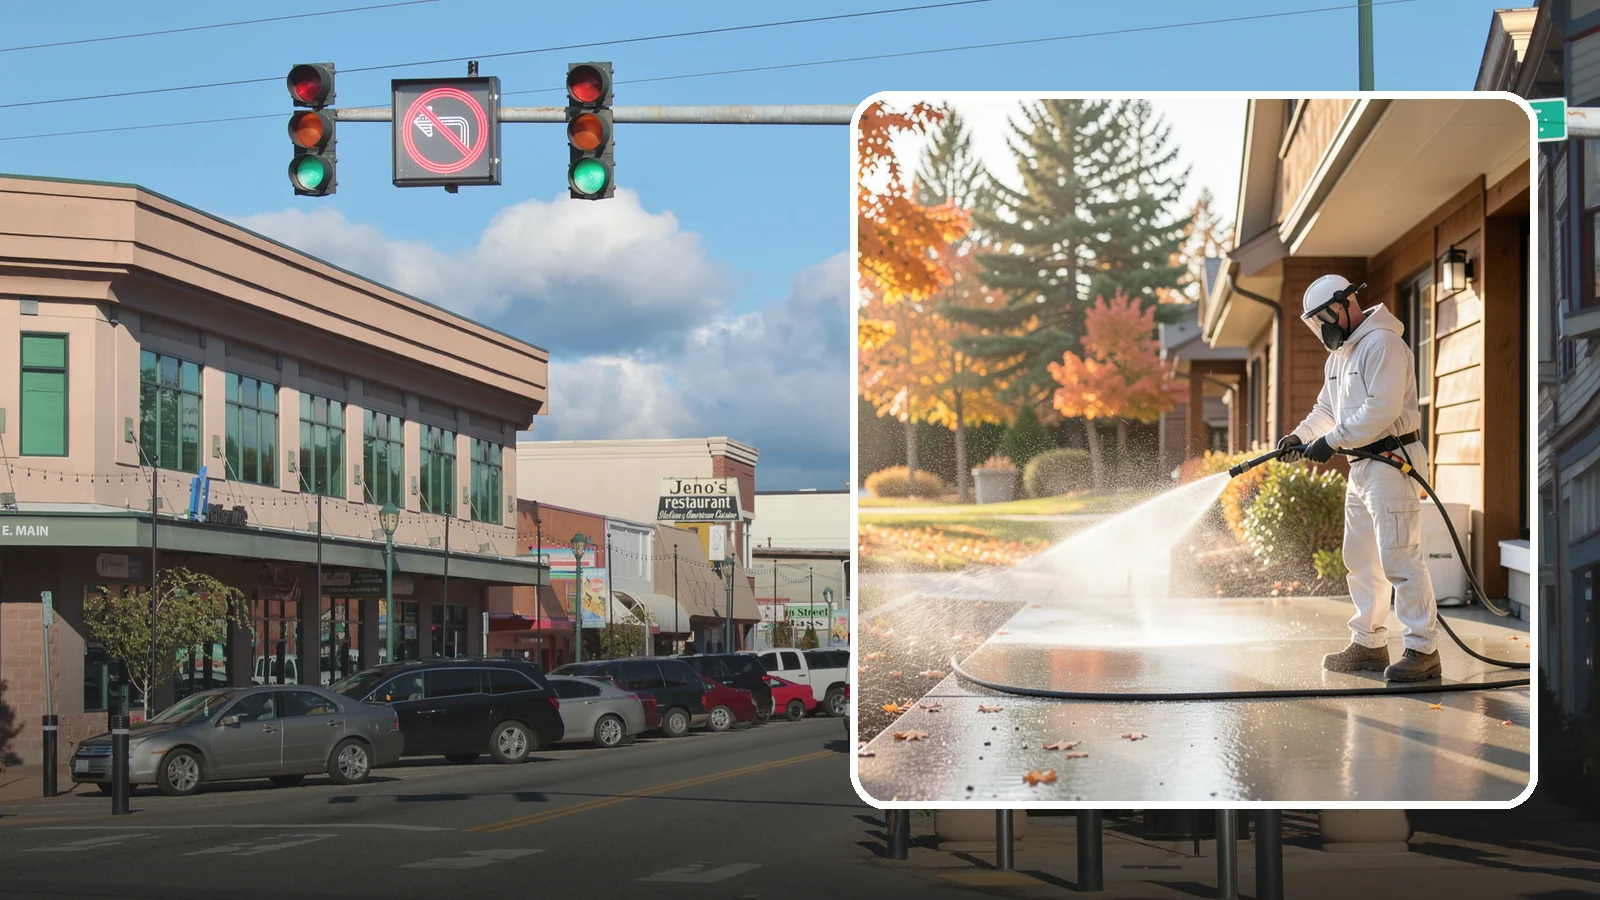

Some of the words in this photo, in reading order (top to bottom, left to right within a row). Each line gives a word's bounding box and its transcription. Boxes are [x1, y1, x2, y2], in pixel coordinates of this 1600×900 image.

[669, 480, 728, 494] Jeno's
[665, 496, 731, 509] restaurant
[659, 510, 681, 520] Italian
[685, 510, 715, 519] American
[715, 510, 737, 520] Cuisine
[2, 525, 13, 536] E.
[15, 525, 49, 536] MAIN
[786, 607, 795, 617] in
[797, 607, 828, 617] Street
[791, 619, 824, 627] lass
